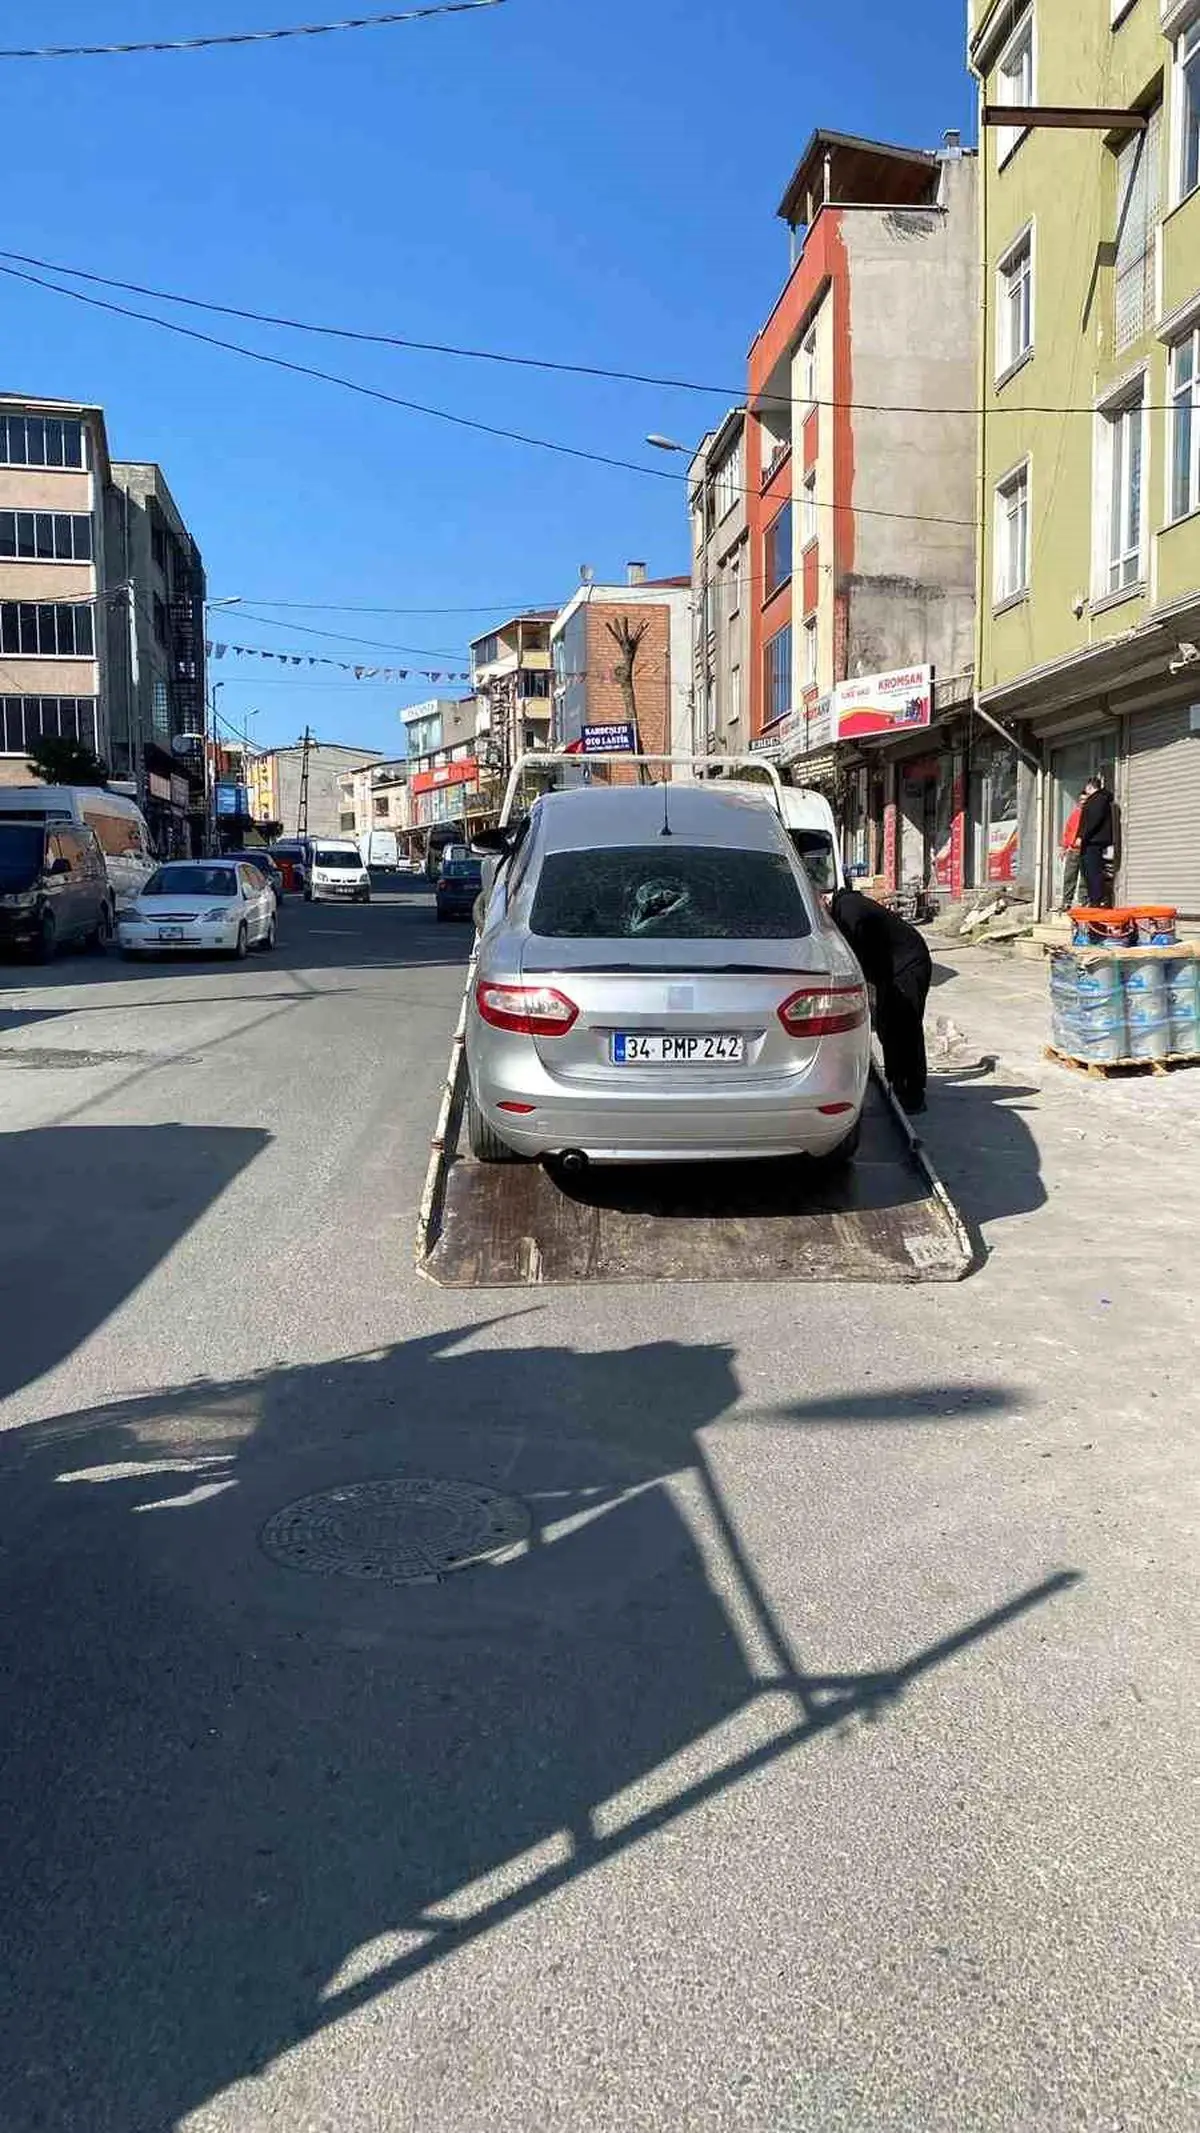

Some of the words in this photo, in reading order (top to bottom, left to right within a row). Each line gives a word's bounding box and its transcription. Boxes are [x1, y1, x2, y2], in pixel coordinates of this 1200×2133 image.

[878, 672, 923, 690] KROMSAN
[628, 1039, 650, 1058] 34
[662, 1038, 698, 1058] PMP
[704, 1037, 739, 1058] 242
